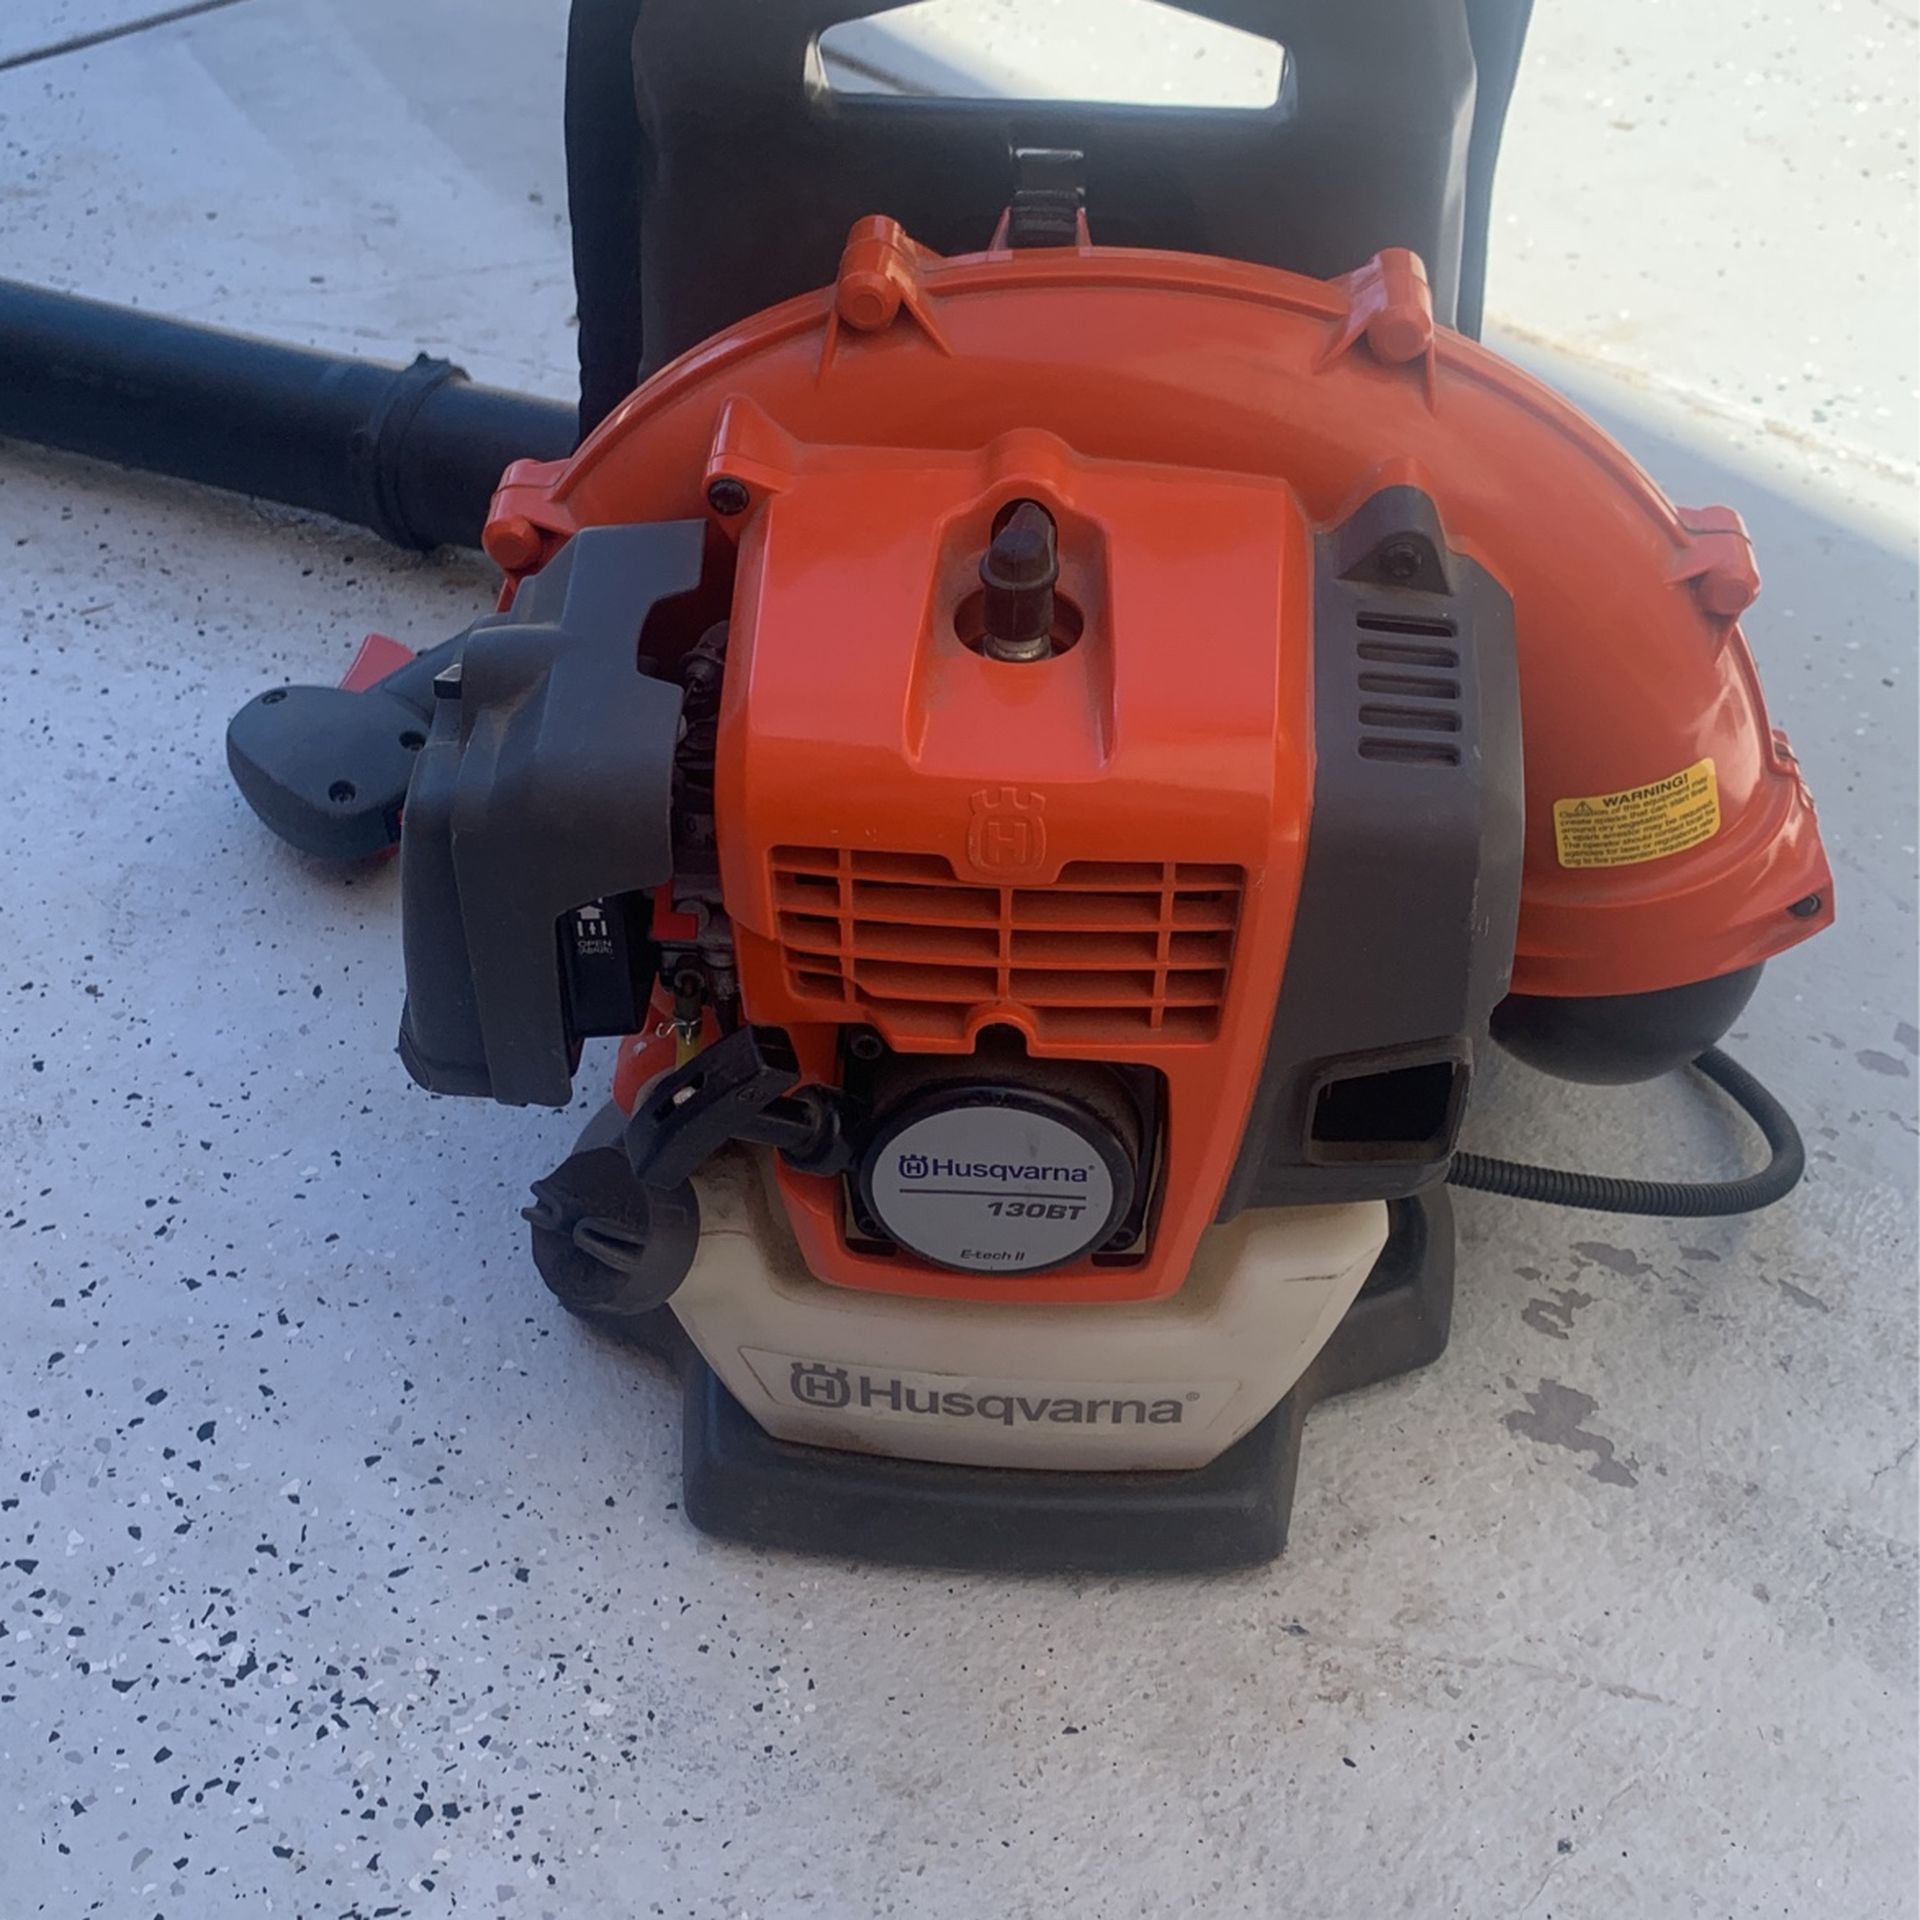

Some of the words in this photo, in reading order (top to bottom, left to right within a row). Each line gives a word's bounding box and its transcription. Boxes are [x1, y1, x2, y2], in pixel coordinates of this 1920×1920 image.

[1602, 773, 1688, 808] WARNING!
[932, 1157, 1088, 1182] Husqvarna
[988, 1202, 1086, 1221] 130BT
[960, 1249, 1011, 1262] E-tech
[859, 1375, 1183, 1426] Husqvarna
